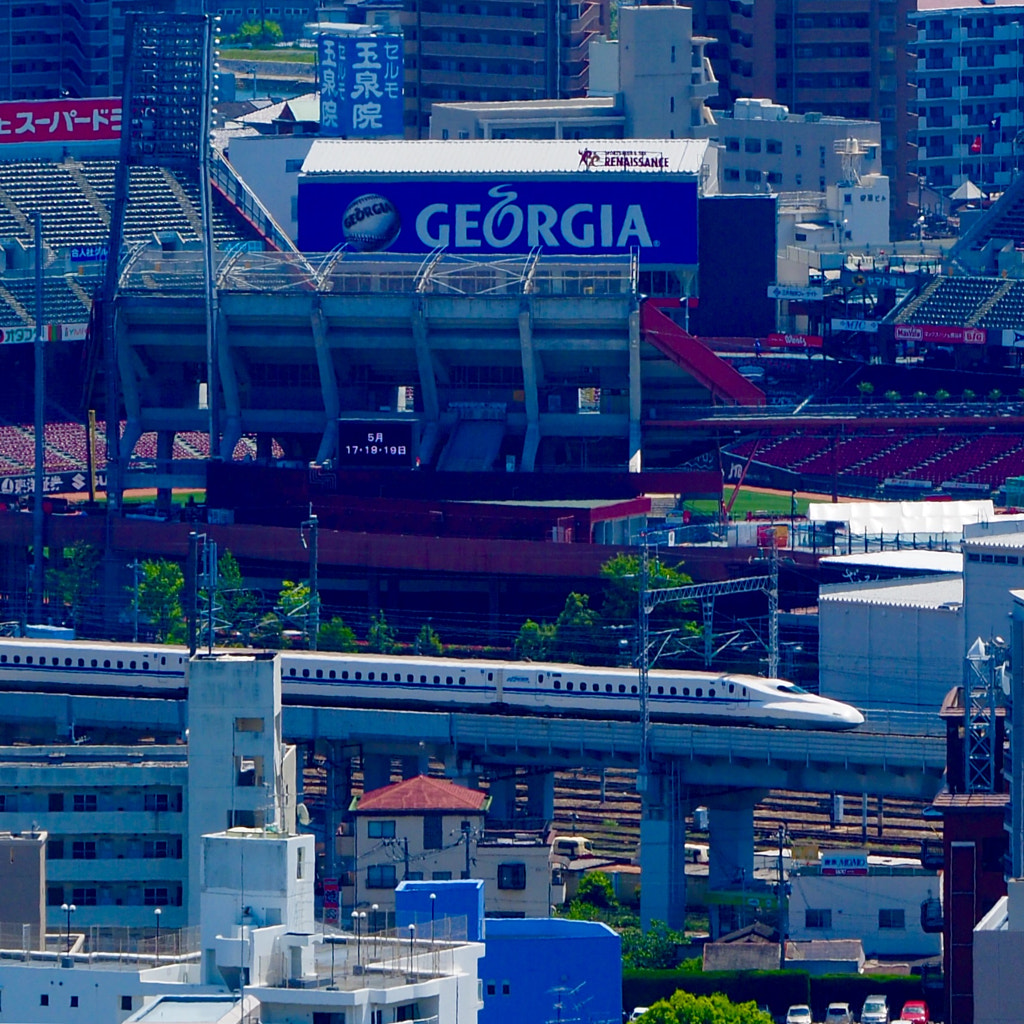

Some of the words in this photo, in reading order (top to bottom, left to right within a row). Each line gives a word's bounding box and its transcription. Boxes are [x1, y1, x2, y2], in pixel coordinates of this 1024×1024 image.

[321, 39, 339, 128] 玉泉院
[350, 42, 384, 129] 玉泉院
[384, 42, 399, 99] セルモ
[604, 156, 669, 168] RENAISSANCE
[343, 202, 393, 229] GEORGIA
[415, 184, 653, 248] GEORGIA
[367, 432, 383, 443] 5月
